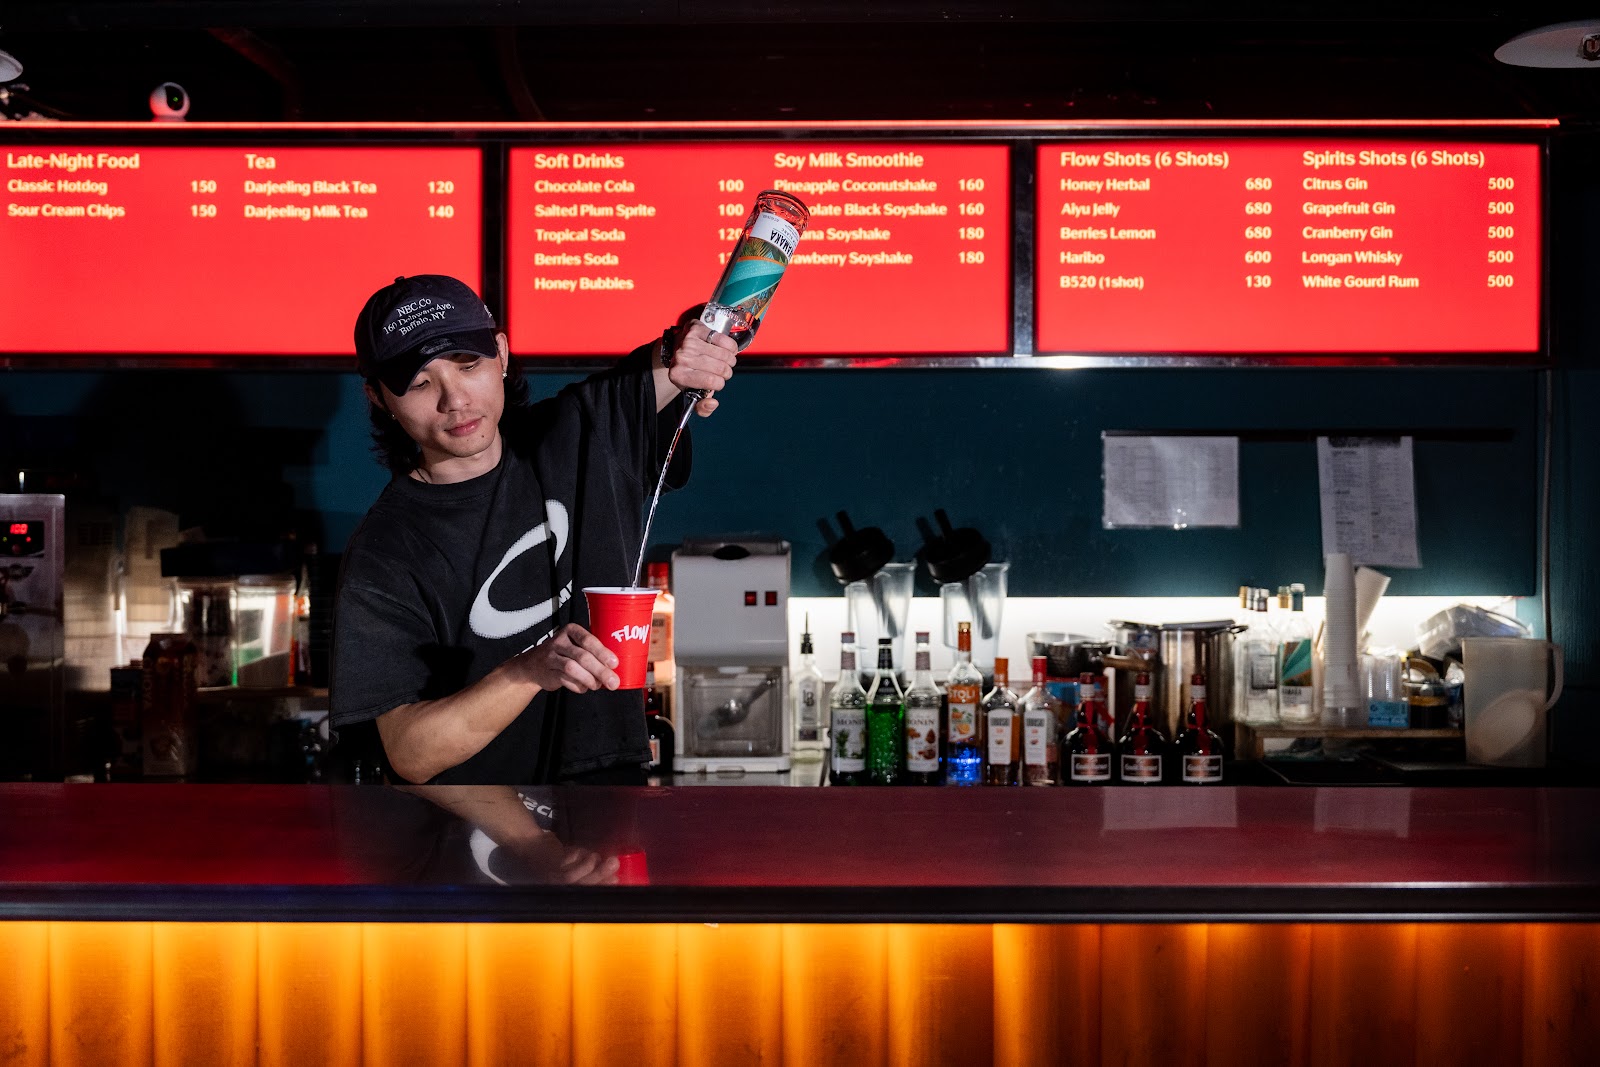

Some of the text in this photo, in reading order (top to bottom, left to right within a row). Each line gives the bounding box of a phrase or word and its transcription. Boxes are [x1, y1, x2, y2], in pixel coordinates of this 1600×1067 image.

[7, 153, 139, 172] Late-Night Food
[245, 154, 276, 169] Tea
[535, 153, 624, 168] Soft Drinks
[774, 152, 924, 171] Soy Milk Smoothie
[1061, 151, 1229, 169] Flow Shots (6 Shots)
[1303, 151, 1485, 169] Spirits Shots (6 Shots)
[8, 179, 217, 195] Classic Hotdog 150
[244, 180, 454, 196] Darjeeling Black Tea 120
[534, 179, 744, 193] Chocolate Cola 100
[774, 178, 984, 195] Pineapple Coconutshake 160
[1060, 178, 1272, 193] Honey Herbal 680
[1303, 177, 1514, 190] Citrus Gin 500
[8, 204, 217, 219] Sour Cream Chips 150
[244, 205, 454, 221] Darjeeling Milk Tea 140
[535, 204, 744, 219] Salted Plum Sprite 100
[810, 203, 984, 219] olate Black Soyshake 160
[1061, 202, 1272, 218] Aiyu Jelly 680
[1303, 202, 1514, 217] Grapefruit Gin 500
[535, 229, 588, 244] Tropical
[590, 228, 625, 241] Soda
[800, 229, 824, 240] ana
[826, 228, 890, 243] Soyshake
[959, 227, 984, 240] 180
[1060, 226, 1272, 240] Berries Lemon 680
[1302, 226, 1514, 241] Cranberry Gin 500
[534, 253, 619, 265] Berries Soda
[789, 251, 984, 267] rawberry Soyshake 180
[1060, 251, 1272, 264] Haribo 600
[1302, 251, 1513, 266] Longan Whisky 500
[534, 277, 634, 292] Honey Bubbles
[1060, 275, 1272, 290] B520 (1shot) 130
[1302, 275, 1513, 288] White Gourd Rum 500
[383, 322, 398, 335] 160
[398, 307, 435, 326] Delaware
[431, 310, 446, 321] NY
[611, 624, 650, 644] FLOW
[907, 718, 935, 726] ONIN
